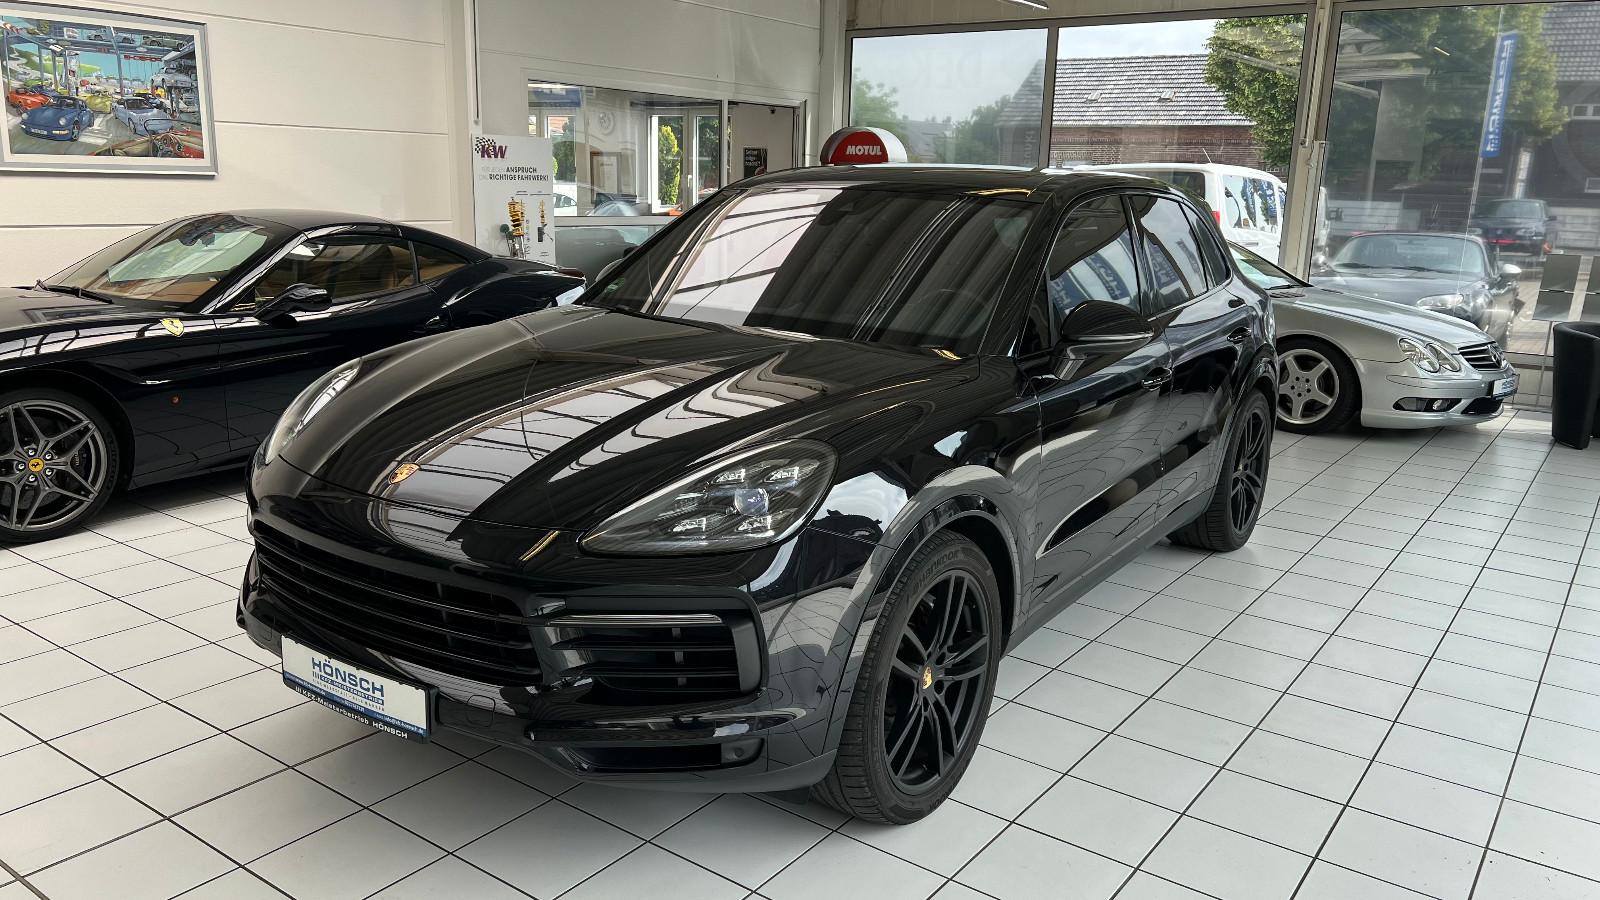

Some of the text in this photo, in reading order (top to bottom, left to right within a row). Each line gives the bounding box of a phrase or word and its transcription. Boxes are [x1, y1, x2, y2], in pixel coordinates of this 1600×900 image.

[480, 143, 508, 158] KW
[845, 145, 882, 155] MOTUL
[505, 166, 537, 174] ANSPRUCH
[489, 173, 516, 181] RICHTIGE
[517, 174, 549, 182] FAHRWERK!
[311, 657, 385, 698] HÖNSCH
[301, 689, 369, 726] KFZ-Meisterbetrieb
[372, 720, 408, 739] HÖNSCH
